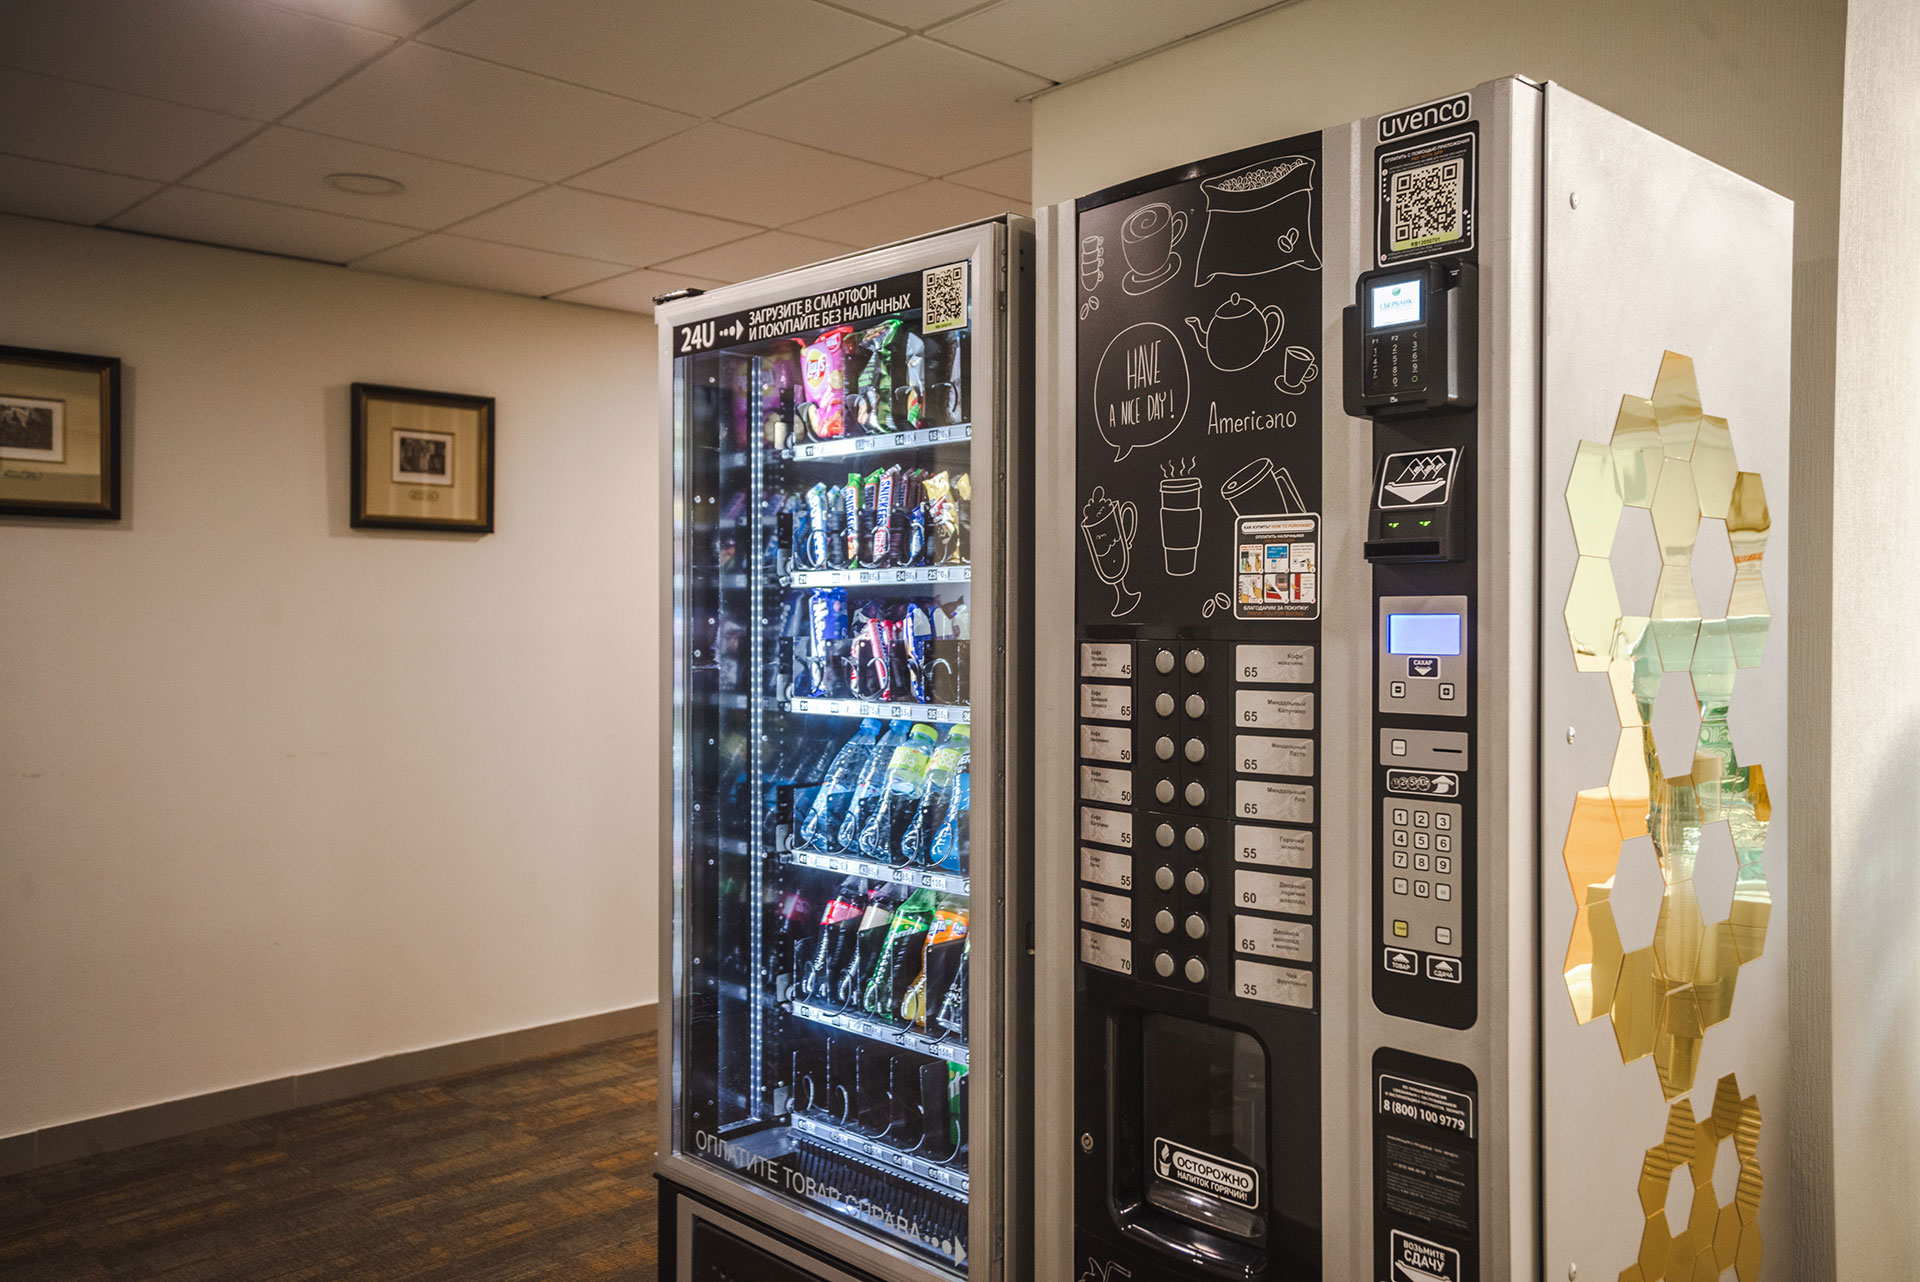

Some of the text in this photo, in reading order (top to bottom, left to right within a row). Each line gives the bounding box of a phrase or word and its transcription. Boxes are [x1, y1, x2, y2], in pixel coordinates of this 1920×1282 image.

[1382, 100, 1466, 137] uvenco
[749, 284, 878, 325] ЗАГРУЗИТЕ В СМАРТФОН
[749, 294, 911, 341] И ПОКУПАЙТЕ БЕЗ НАЛИЧНЫХ
[680, 321, 716, 352] 24U
[1127, 340, 1161, 390] HAVE
[1109, 404, 1116, 428] A
[1121, 397, 1141, 425] NICE
[1208, 401, 1297, 435] Americano
[929, 430, 938, 440] 15
[876, 480, 891, 528] SNICKERS
[897, 572, 905, 581] 24
[928, 570, 937, 579] 25
[1121, 664, 1131, 675] 45
[1244, 666, 1258, 678] 65
[892, 707, 900, 717] 34
[928, 709, 936, 719] 35
[1121, 706, 1131, 717] 65
[1244, 710, 1258, 722] 65
[1121, 750, 1131, 760] 50
[1244, 759, 1258, 770] 65
[1121, 791, 1131, 801] 50
[1244, 803, 1258, 814] 65
[1397, 813, 1402, 822] 1
[1418, 815, 1425, 824] 2
[1440, 817, 1447, 826] 3
[1121, 832, 1131, 843] 55
[1397, 834, 1404, 843] 4
[1418, 836, 1425, 845] 5
[1440, 839, 1447, 848] 6
[1243, 847, 1257, 859] 55
[1397, 855, 1404, 864] 7
[1418, 858, 1425, 867] 8
[1440, 861, 1447, 869] 9
[893, 871, 901, 880] 44
[922, 876, 930, 885] 45
[1121, 875, 1131, 886] 55
[1419, 884, 1426, 893] 0
[1243, 892, 1257, 904] 60
[1120, 917, 1130, 929] 50
[1242, 939, 1256, 951] 65
[1121, 959, 1131, 970] 70
[1243, 983, 1257, 996] 35
[930, 1042, 938, 1052] 55
[1383, 1099, 1465, 1131] 8 (800) 100 9779
[893, 1155, 901, 1164] 64
[1177, 1156, 1249, 1189] ОСТОРОЖНО
[695, 1130, 923, 1247] ОПЛАТИТЕ ТОВАР СПРАВА
[1177, 1170, 1248, 1201] НАПИТОК ГОРЯЧИЙ!
[1403, 1239, 1446, 1260] ВОЗЬМИТЕ
[1404, 1249, 1445, 1273] СДАЧУ
